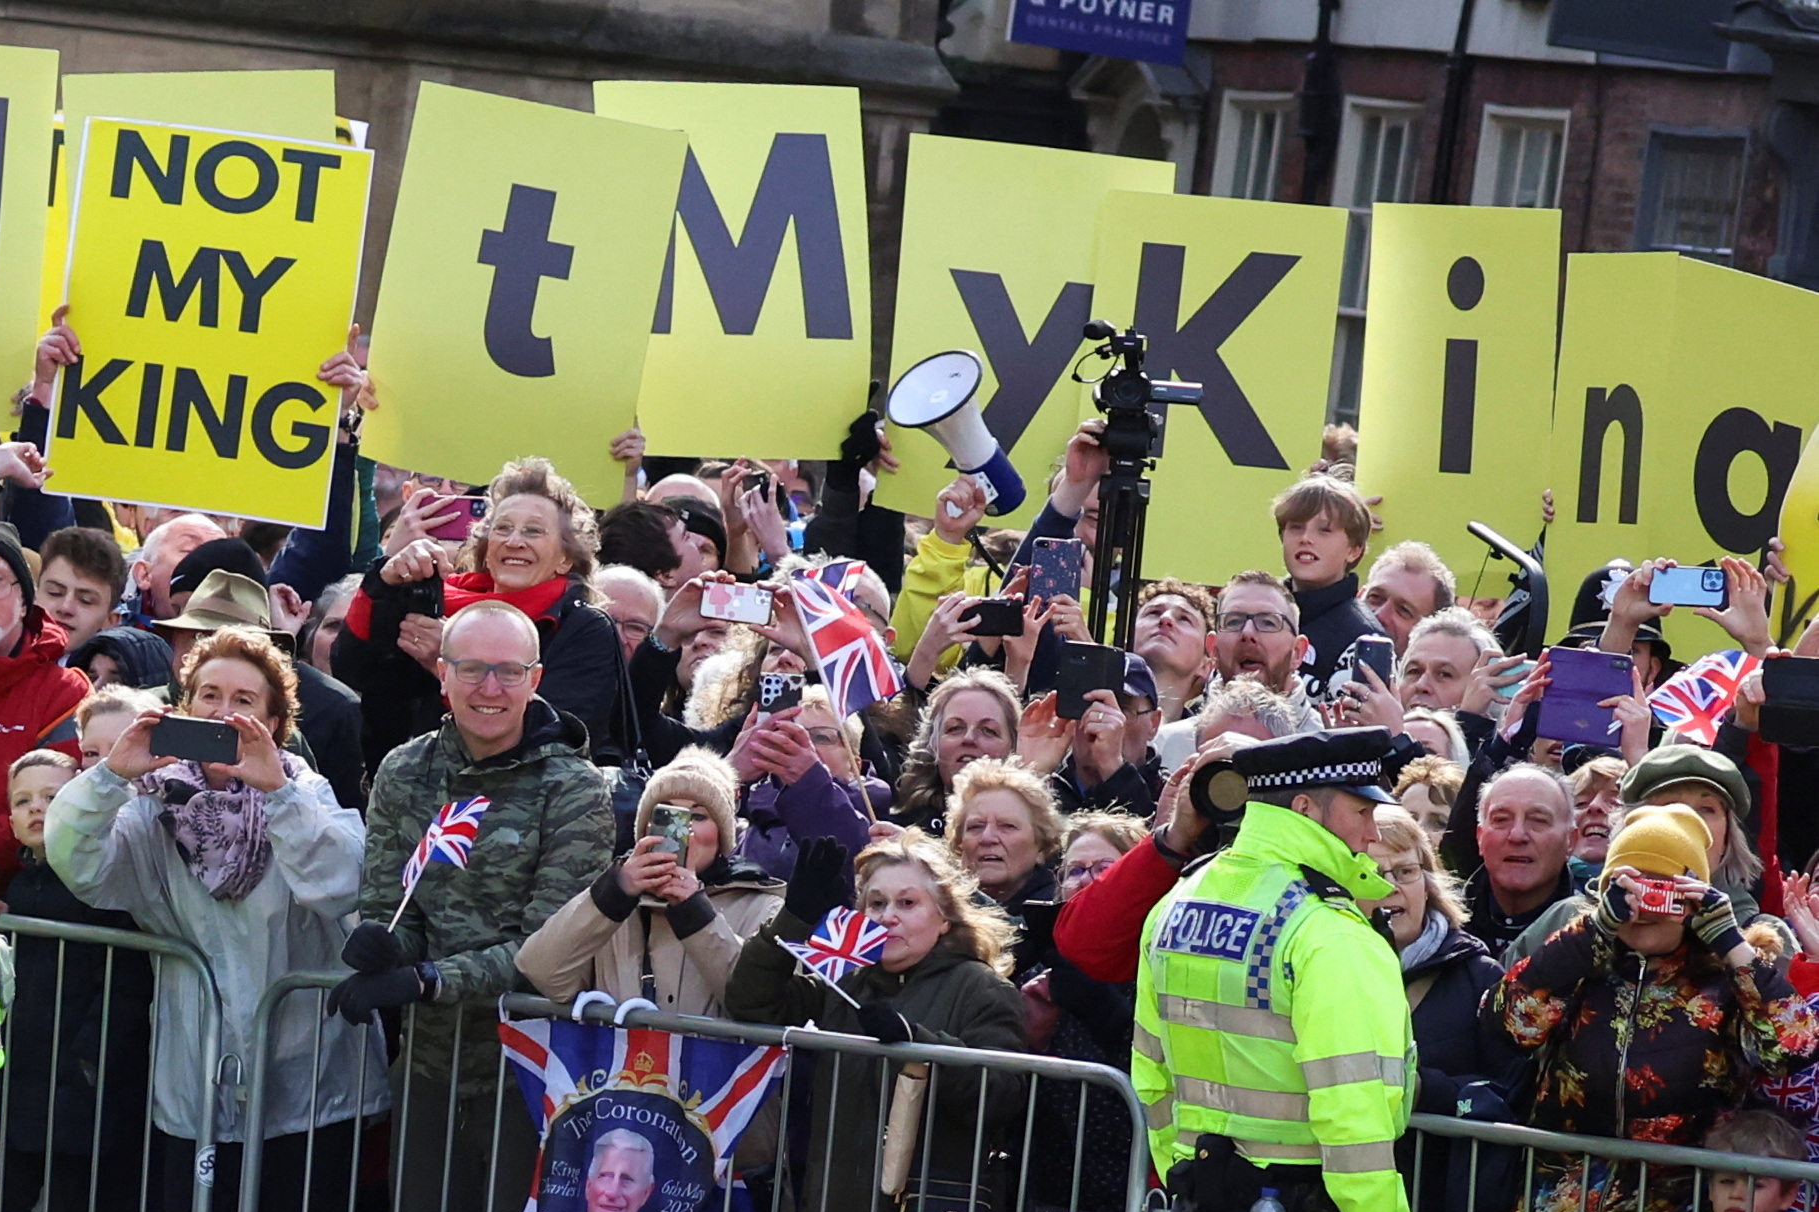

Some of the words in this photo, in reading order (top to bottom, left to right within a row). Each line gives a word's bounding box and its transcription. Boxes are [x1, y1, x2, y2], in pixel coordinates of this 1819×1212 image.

[110, 128, 342, 223] NOT
[125, 238, 298, 334] MY
[55, 355, 331, 470] KING
[551, 1160, 581, 1184] King
[680, 1182, 706, 1204] May
